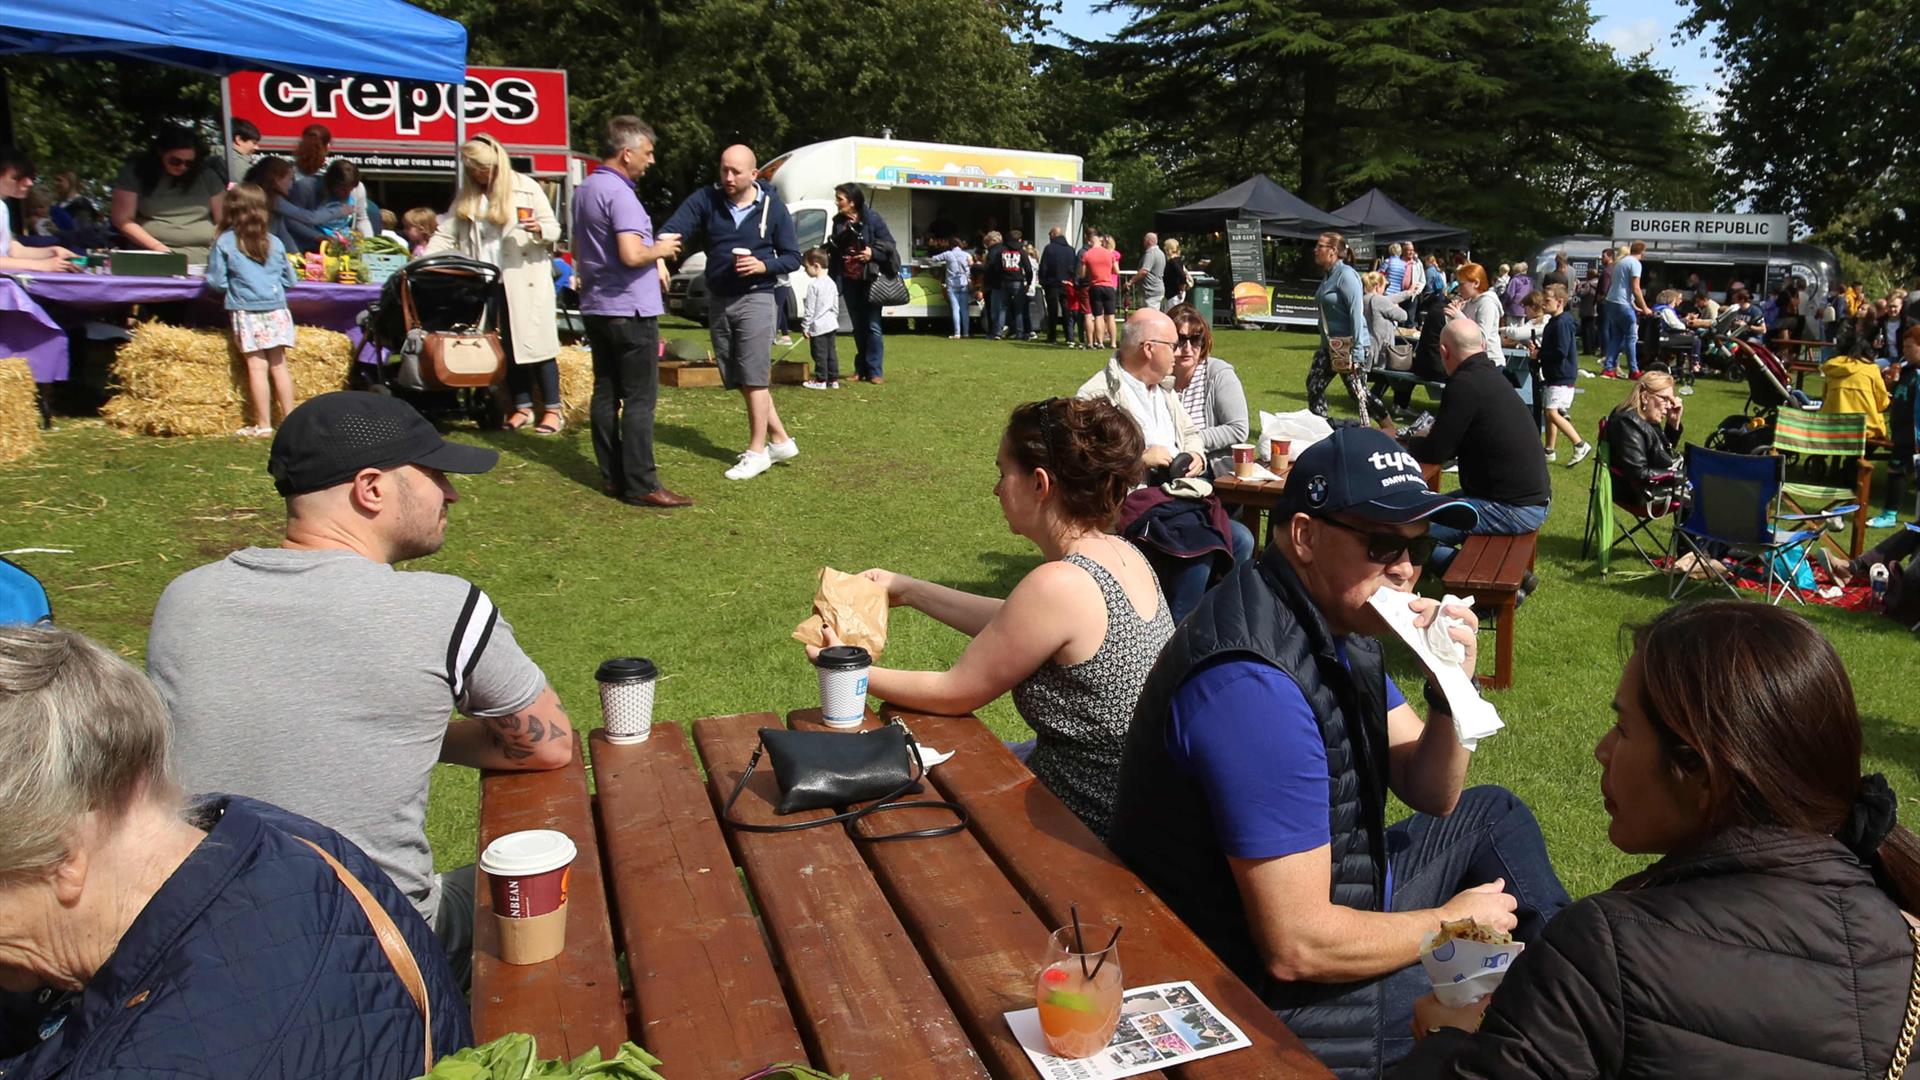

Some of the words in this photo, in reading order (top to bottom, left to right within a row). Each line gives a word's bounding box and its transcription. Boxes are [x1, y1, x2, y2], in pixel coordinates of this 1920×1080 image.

[432, 159, 456, 168] mang
[1630, 219, 1691, 233] BURGER
[1694, 220, 1770, 235] REPUBLIC
[1381, 474, 1406, 487] BMW
[508, 880, 520, 920] NBEAN
